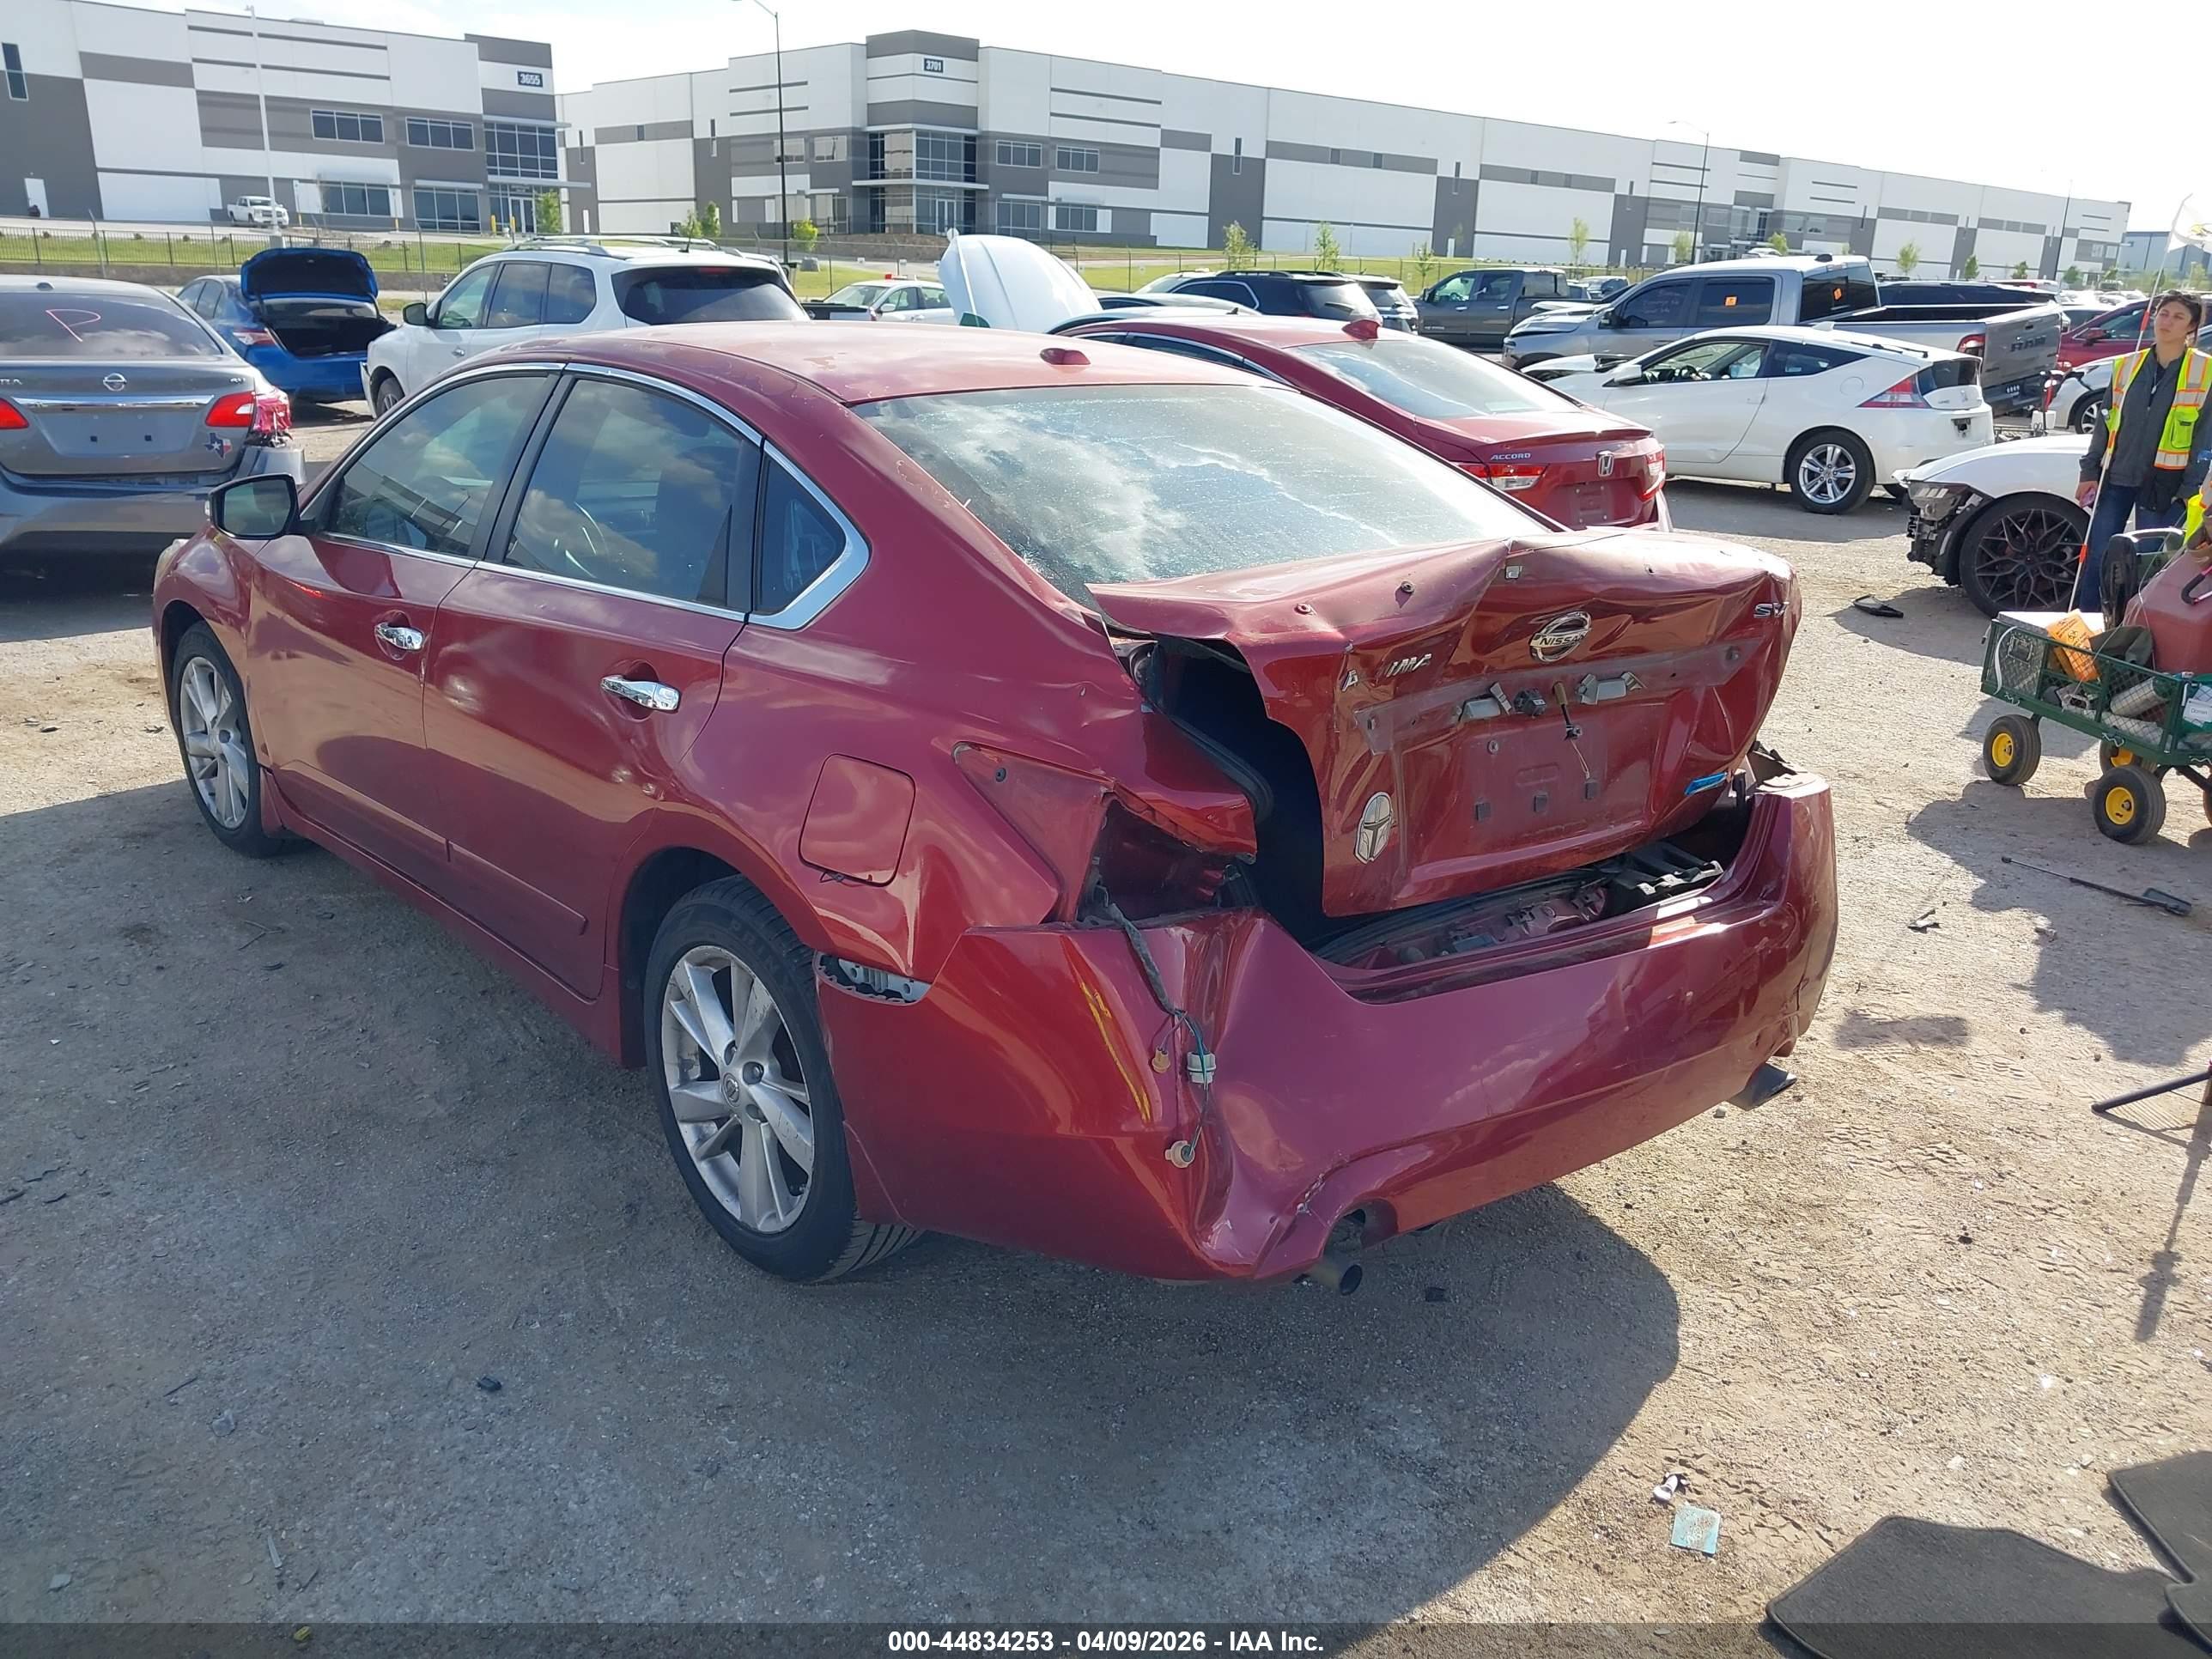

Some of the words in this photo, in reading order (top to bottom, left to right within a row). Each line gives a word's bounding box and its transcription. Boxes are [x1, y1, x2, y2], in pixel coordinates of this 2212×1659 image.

[927, 60, 942, 71] 3701
[1491, 453, 1531, 461] ACCORD
[1753, 601, 1790, 618] SV
